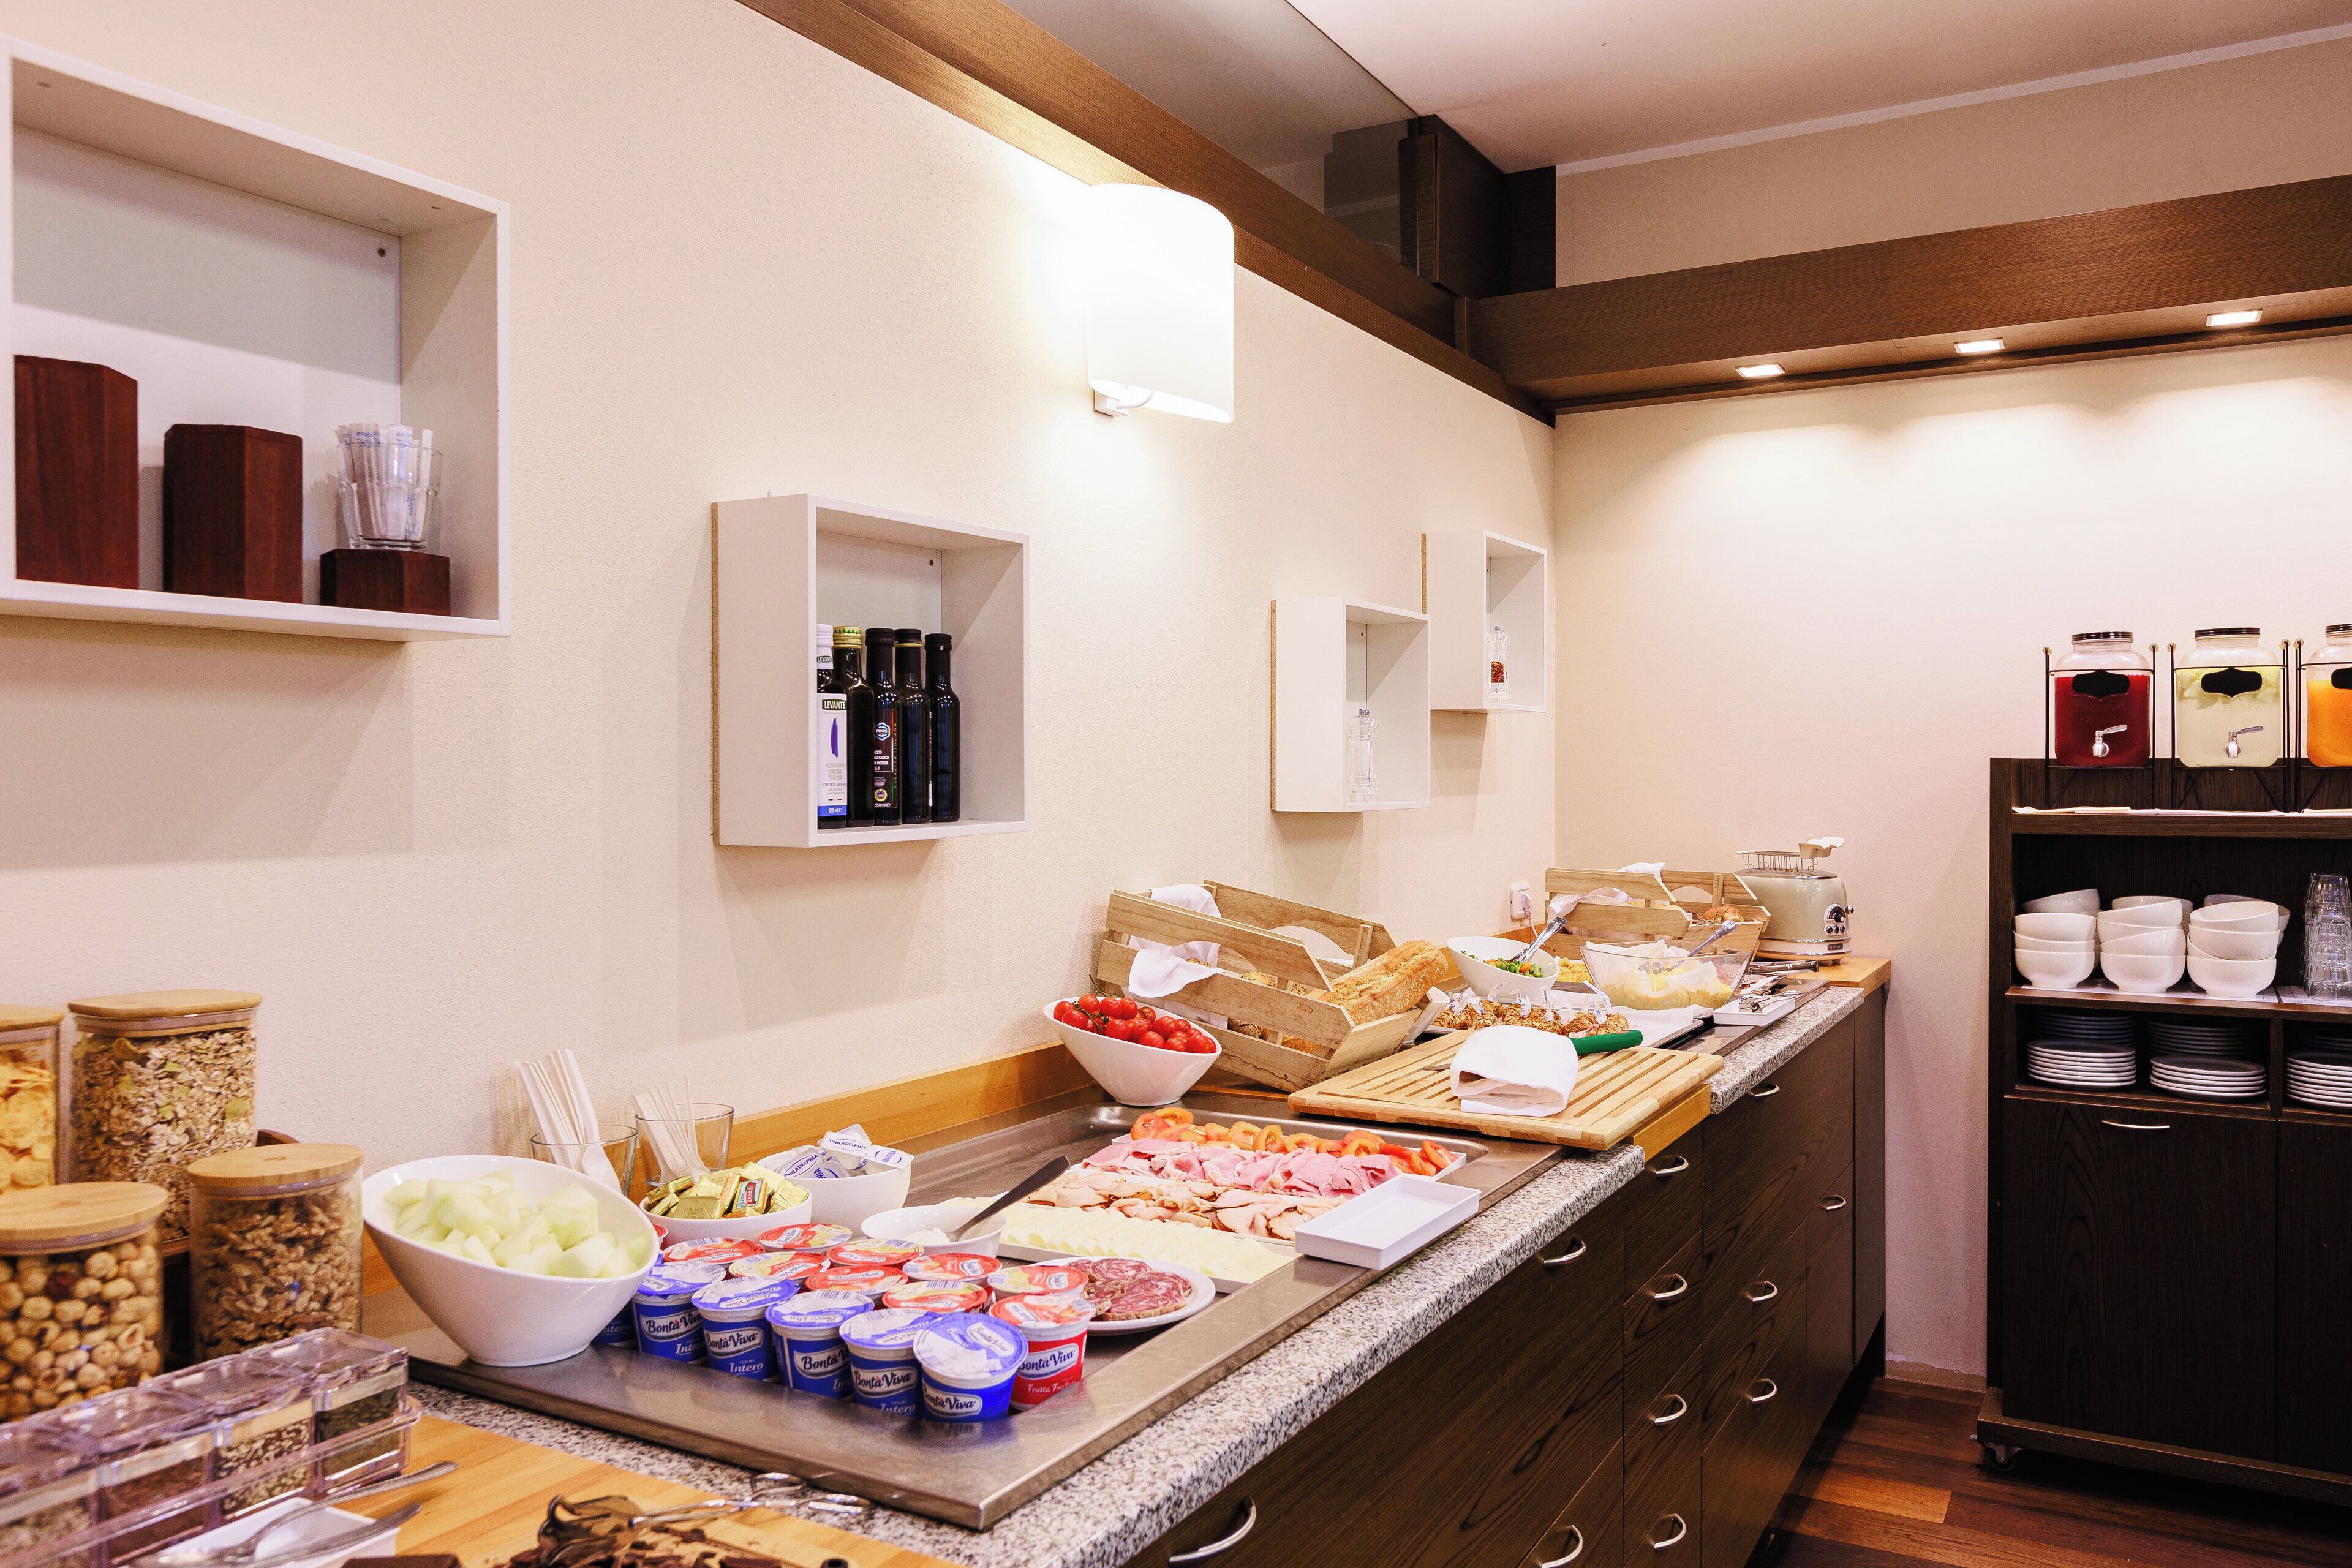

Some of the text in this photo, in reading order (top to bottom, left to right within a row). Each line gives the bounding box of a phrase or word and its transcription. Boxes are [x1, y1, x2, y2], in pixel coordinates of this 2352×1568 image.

[824, 701, 846, 709] LEVANTE
[829, 1139, 867, 1150] PHILADELPHIA
[783, 1155, 818, 1177] PHILADELPHIA
[646, 1319, 680, 1333] Bontà
[729, 1332, 758, 1348] Viva
[801, 1352, 839, 1370] Bontà
[1050, 1351, 1075, 1366] Viva
[729, 1363, 764, 1373] Intero
[882, 1372, 913, 1387] Viva
[1027, 1384, 1050, 1393] Frutta
[945, 1396, 975, 1410] Viva
